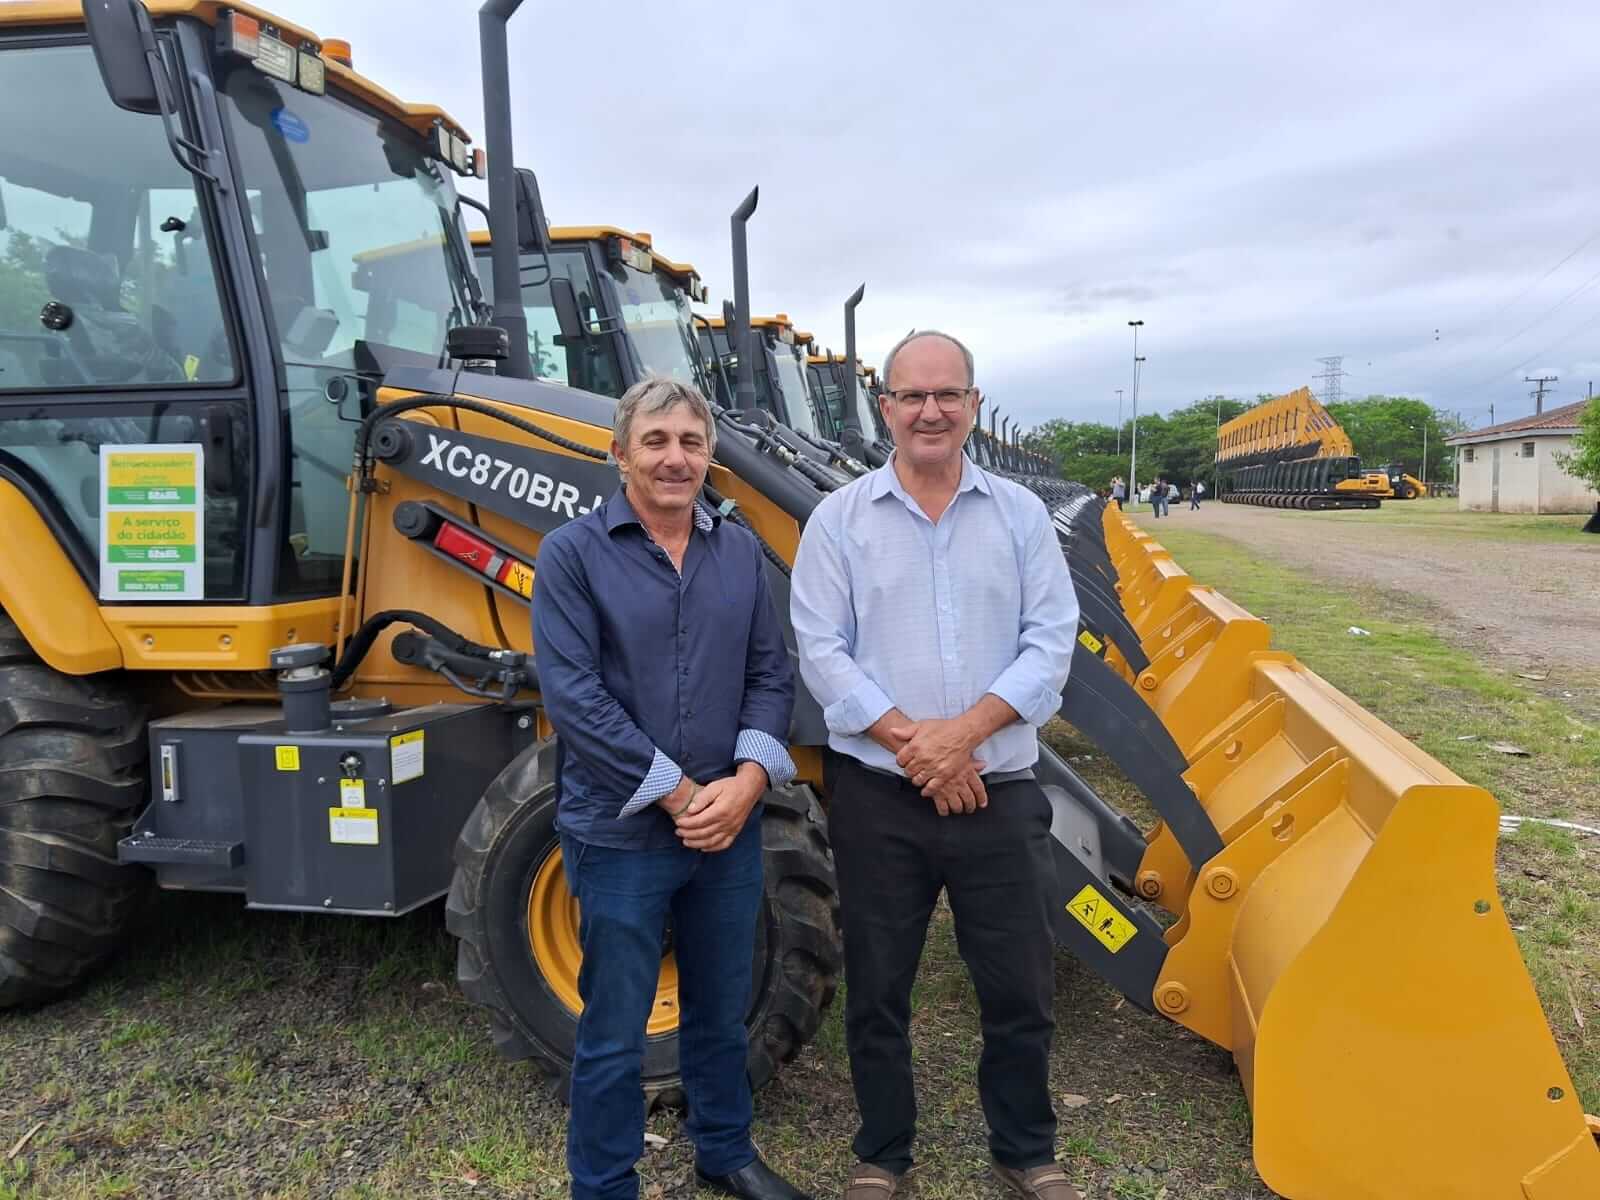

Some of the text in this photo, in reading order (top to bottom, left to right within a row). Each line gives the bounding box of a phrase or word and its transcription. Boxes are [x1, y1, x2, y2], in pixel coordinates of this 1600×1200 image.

[135, 517, 181, 529] serviço
[117, 529, 186, 540] do cidadão
